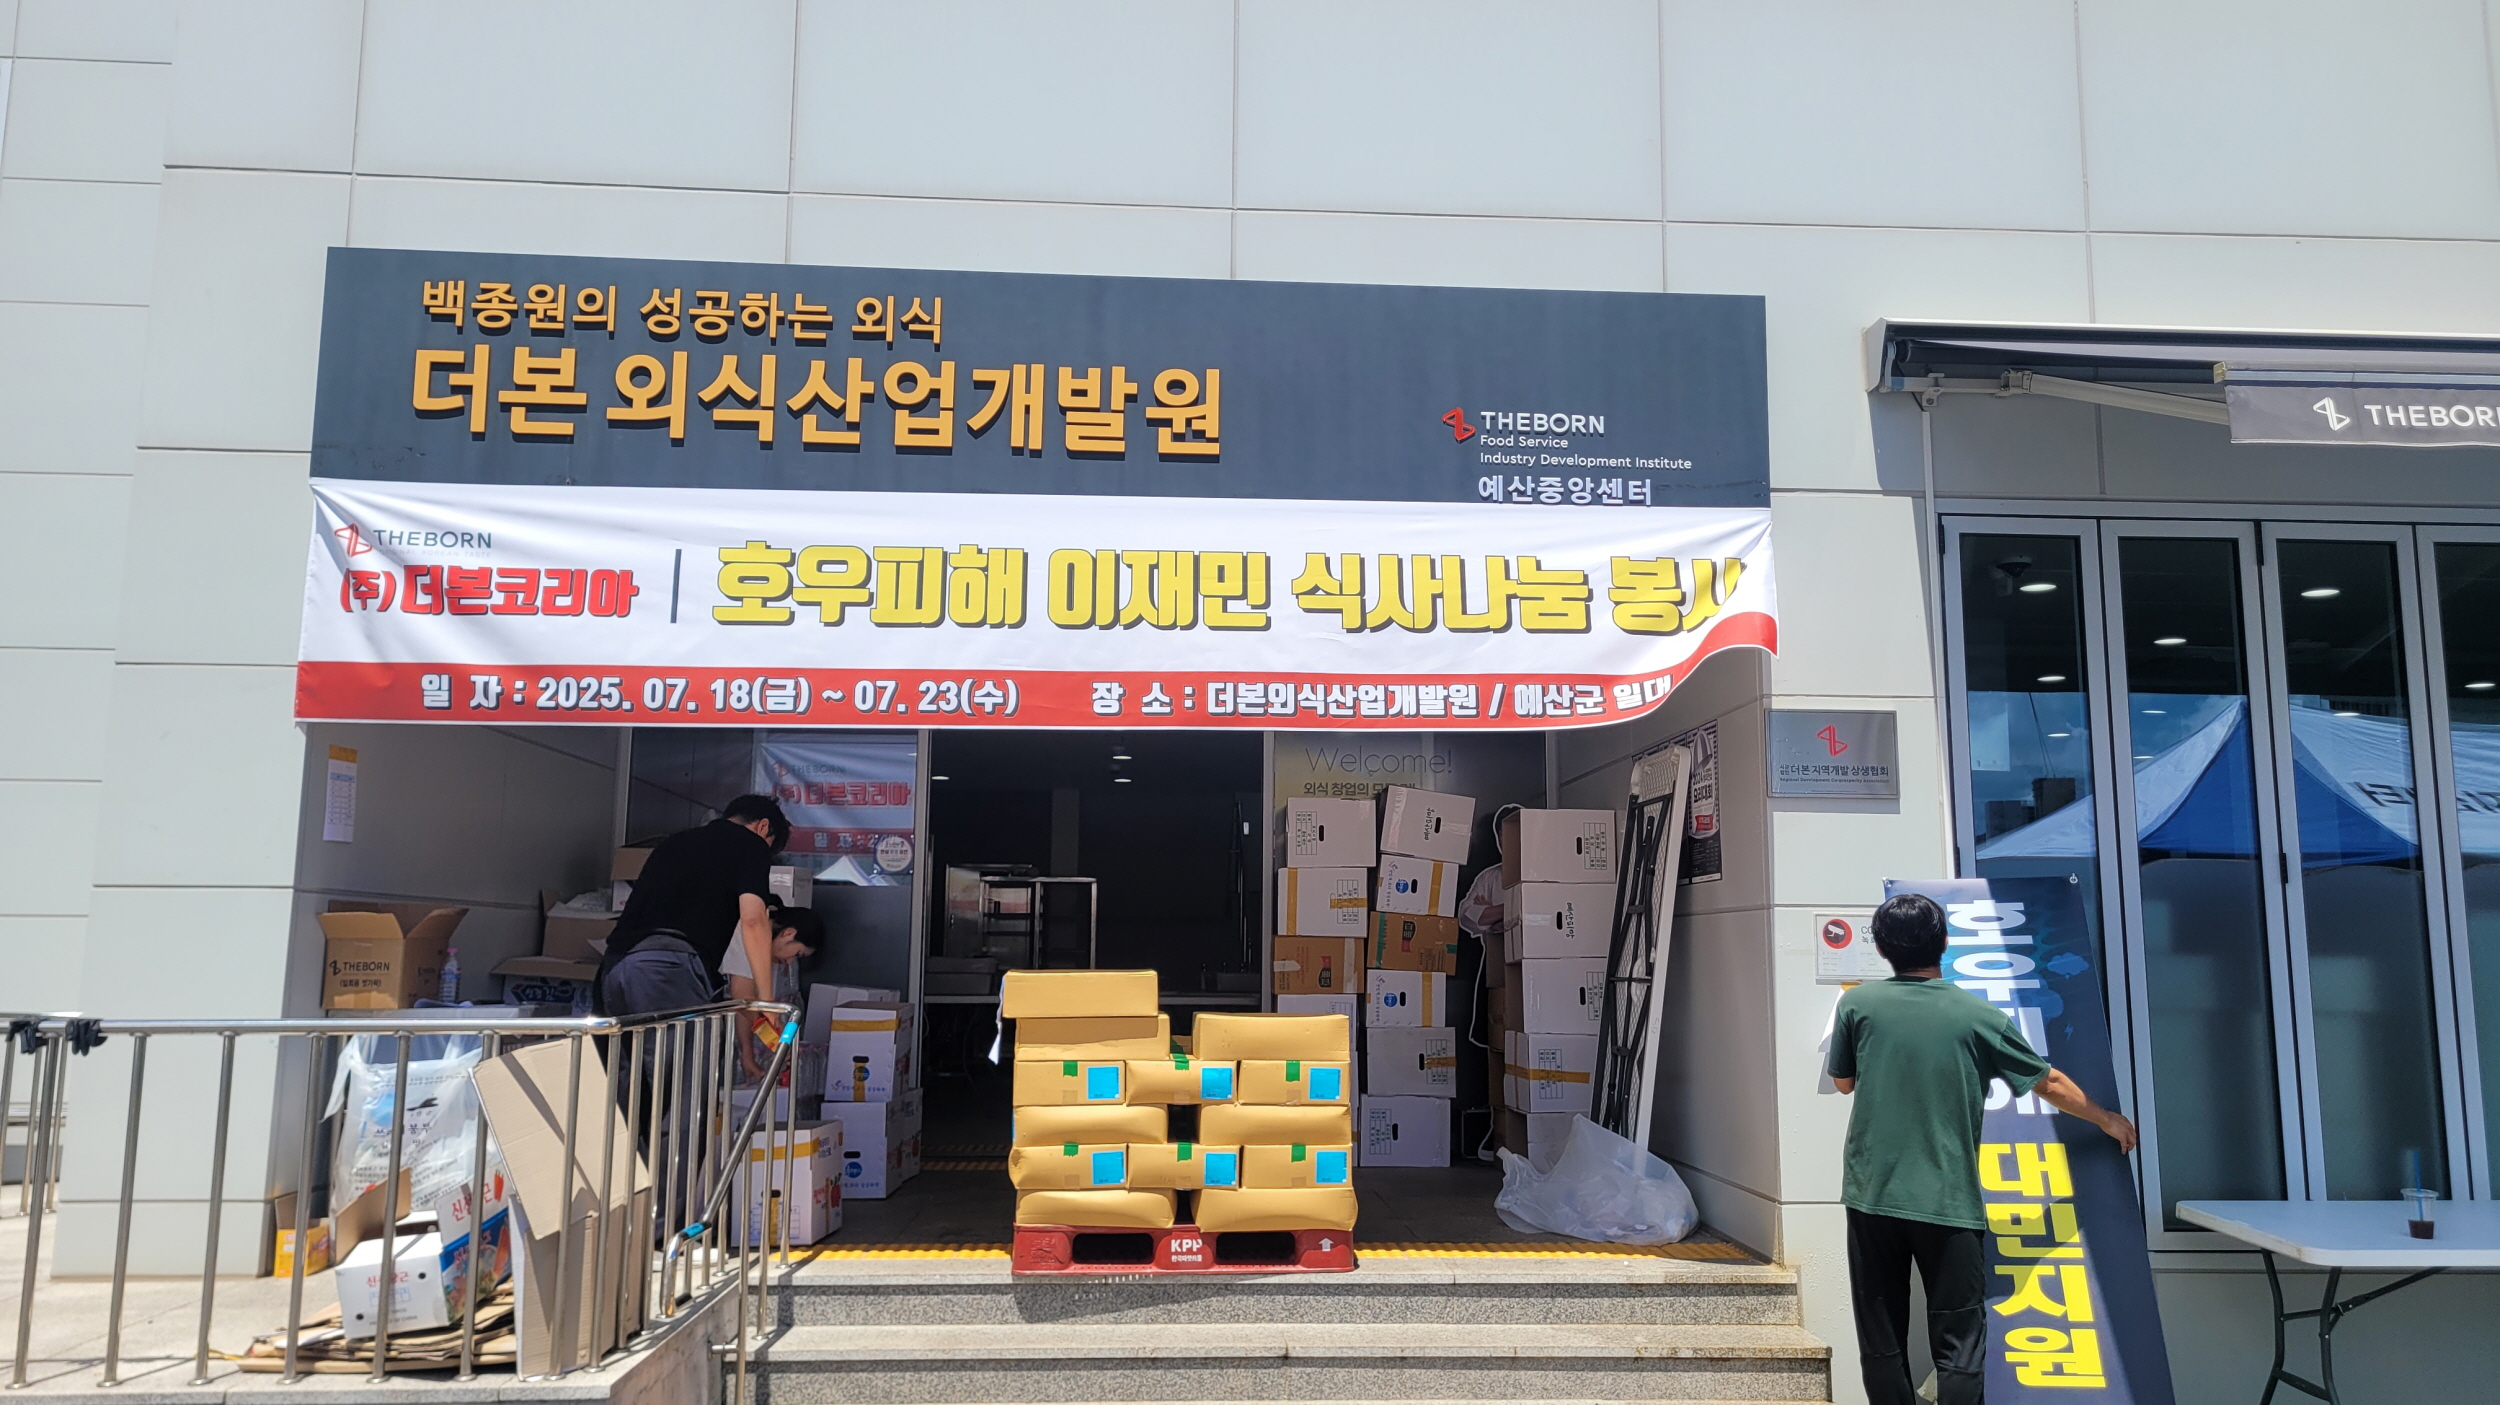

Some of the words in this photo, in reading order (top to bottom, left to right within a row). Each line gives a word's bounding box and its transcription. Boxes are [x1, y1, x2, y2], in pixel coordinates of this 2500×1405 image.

[422, 281, 616, 332] 백종원의
[640, 288, 833, 341] 성공하는
[851, 296, 942, 344] 외식
[1480, 411, 1605, 434] THEBORN
[1480, 435, 1514, 447] Food
[1519, 436, 1568, 448] Service
[1480, 452, 1536, 466] Industry
[1541, 454, 1631, 469] Development
[1636, 457, 1692, 469] Institute
[1478, 475, 1652, 505] 예산중앙센터
[373, 529, 492, 549] THEBORN
[340, 564, 640, 619] (주)더본코리아
[712, 541, 1028, 628] 호우피해
[1047, 548, 1272, 630] 이재민
[1291, 551, 1594, 633] 식사나눔
[536, 676, 634, 712] 2025.
[642, 678, 697, 713] 07.
[710, 678, 812, 715] 18(금)
[853, 679, 907, 715] 07.
[917, 678, 1021, 718] 23(수)
[1207, 680, 1478, 719] 더본외식산업개발원
[1514, 681, 1605, 718] 예산군
[1614, 673, 1675, 708] 일대
[1812, 764, 1849, 776] 지역개발
[1851, 765, 1889, 777] 상생협회
[1304, 782, 1328, 796] 외식
[1331, 781, 1369, 797] 창업의
[342, 961, 390, 971] THEBORN
[1171, 1238, 1203, 1252] KPP
[1978, 1143, 2106, 1387] 대민지원
